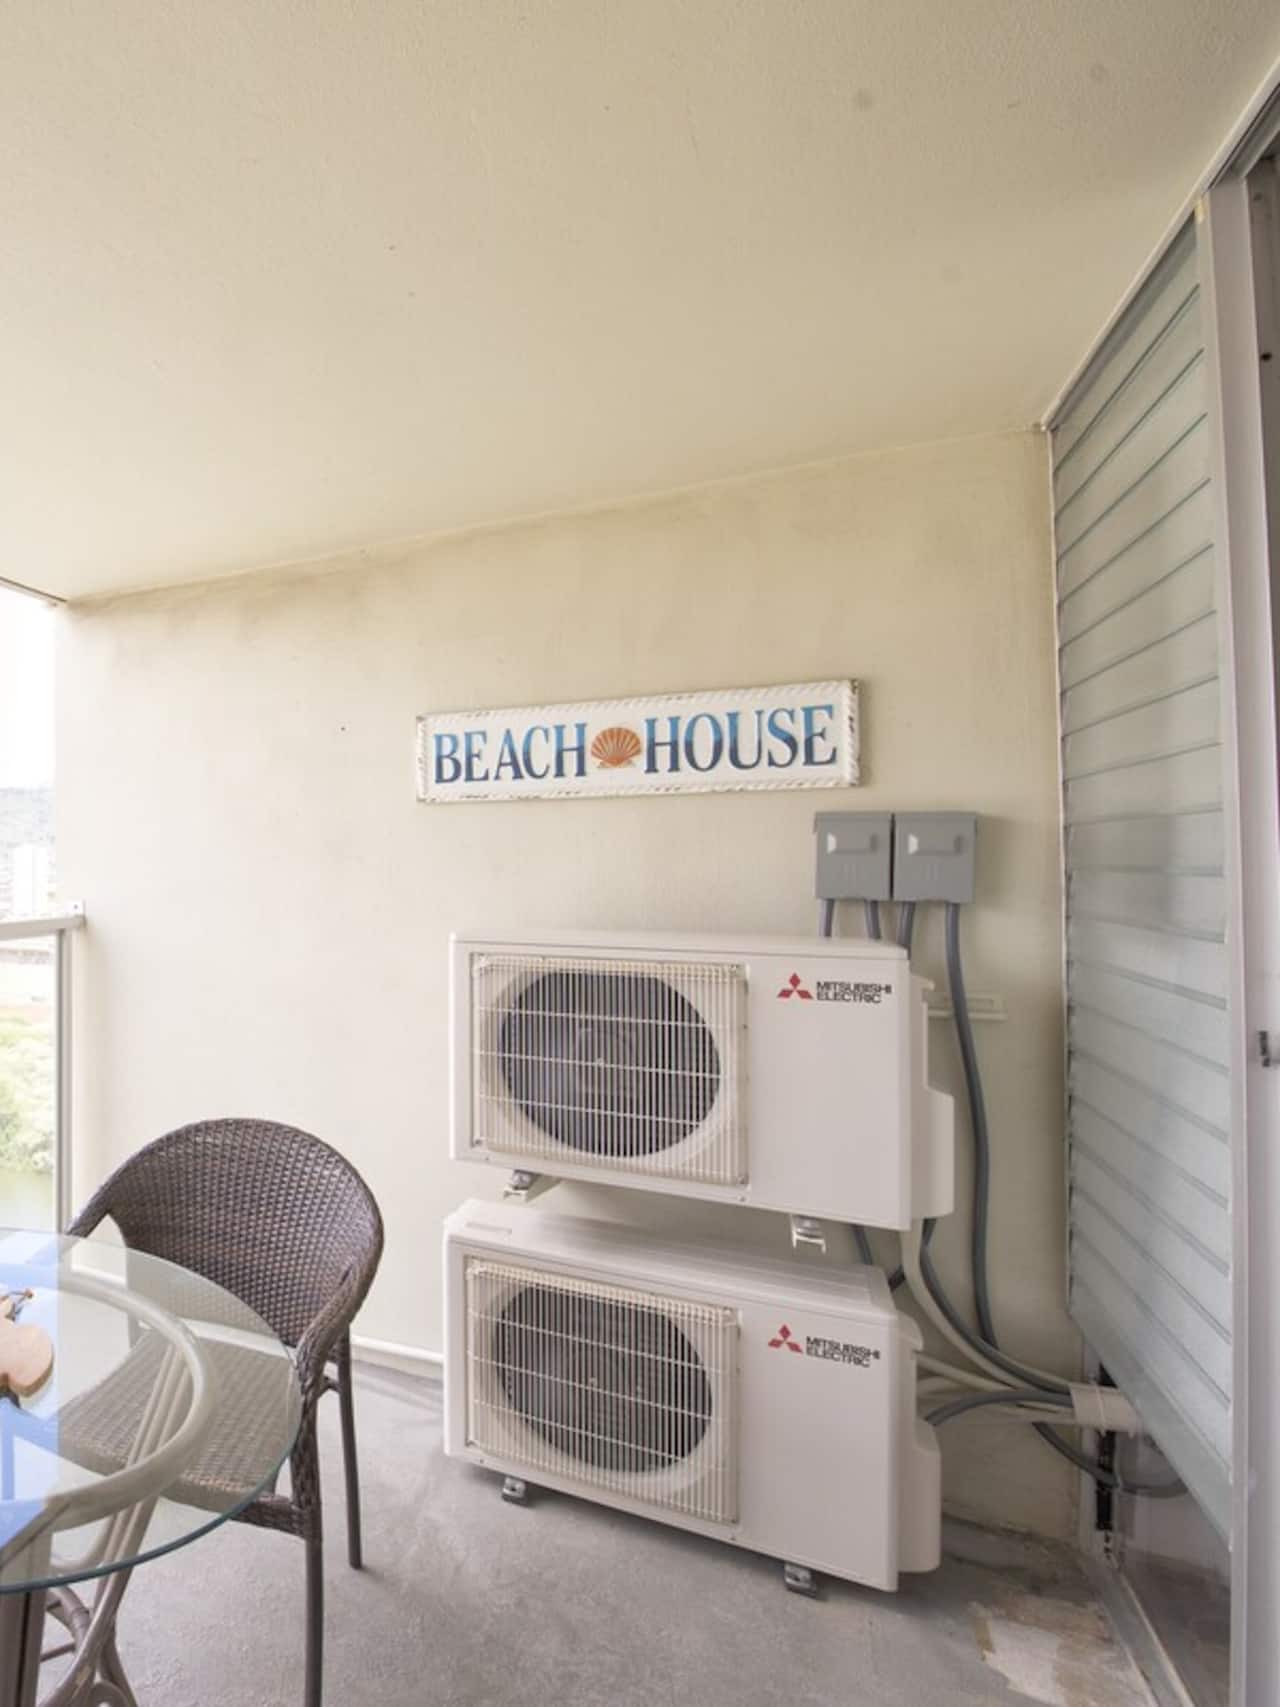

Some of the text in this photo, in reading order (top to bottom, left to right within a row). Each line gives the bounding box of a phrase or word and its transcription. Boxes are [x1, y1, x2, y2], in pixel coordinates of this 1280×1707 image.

[433, 704, 838, 784] BEACH HOUSE
[816, 981, 892, 994] MITSUBISHI
[816, 991, 882, 1004] ELECTRIC
[805, 1336, 881, 1360] MITSUBISHI
[805, 1345, 870, 1368] ELECTRIC
